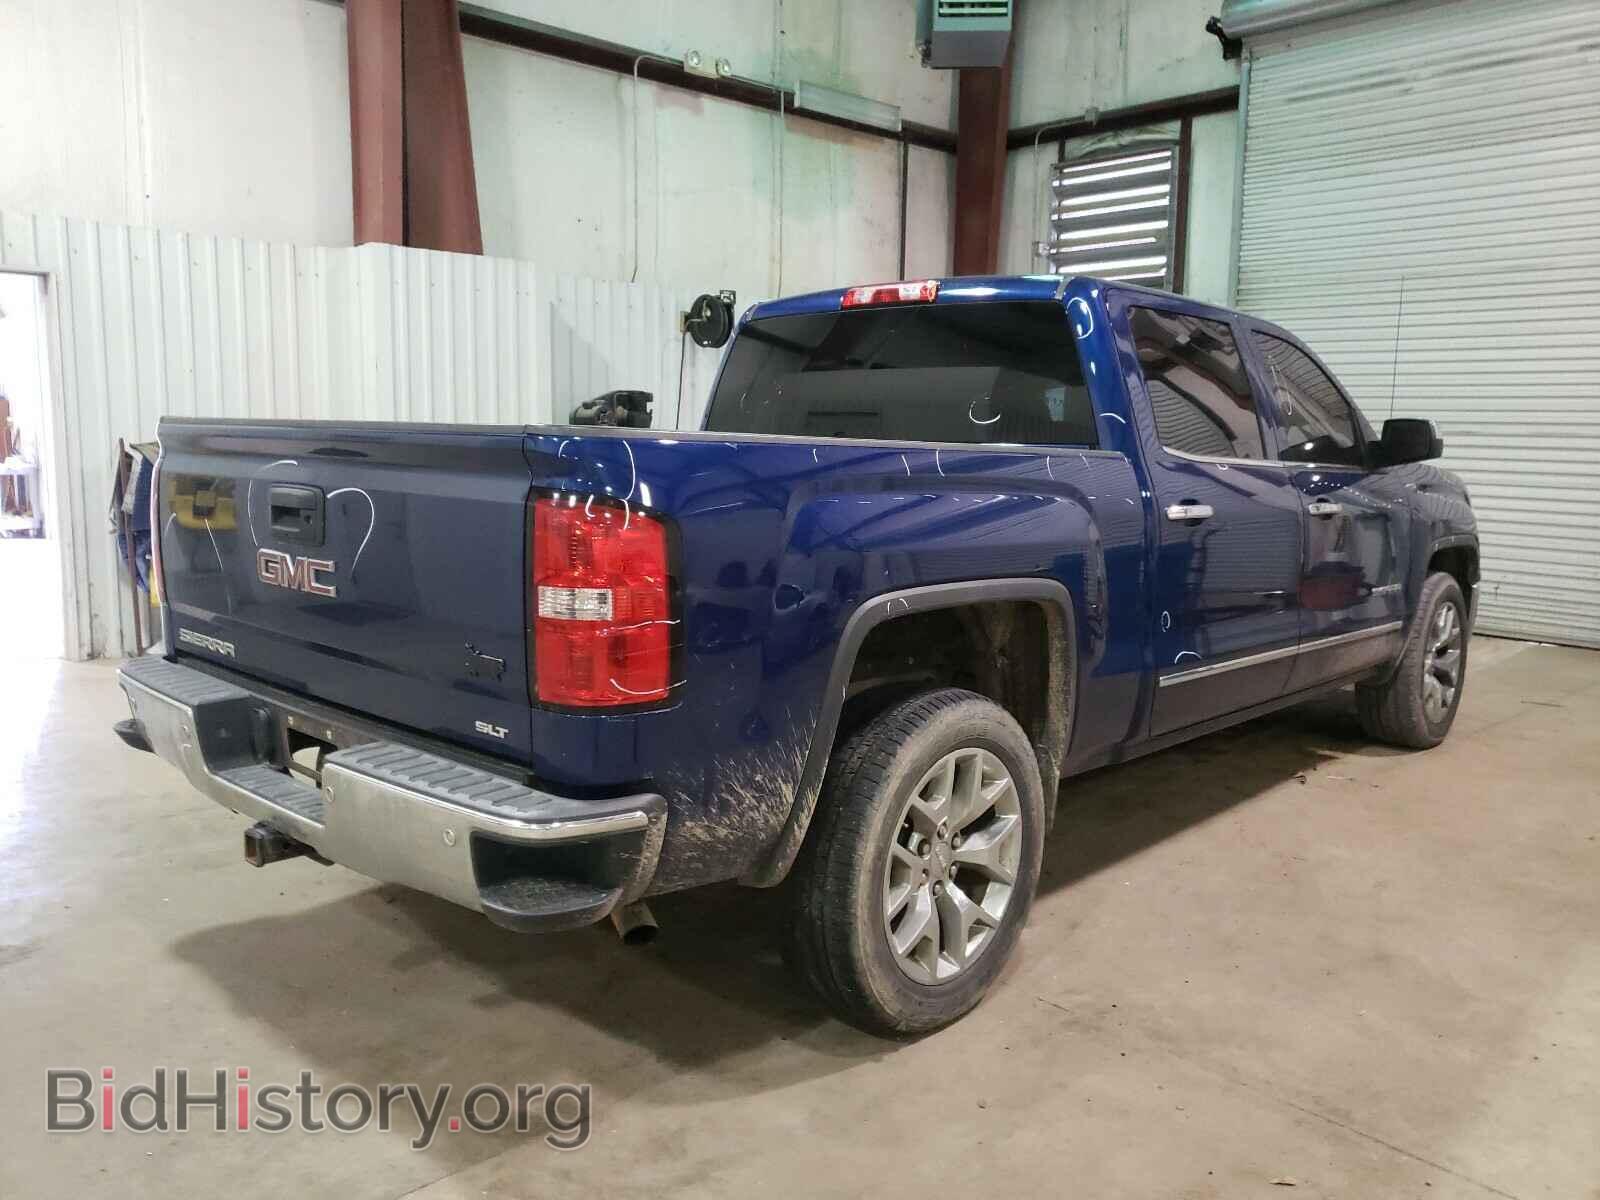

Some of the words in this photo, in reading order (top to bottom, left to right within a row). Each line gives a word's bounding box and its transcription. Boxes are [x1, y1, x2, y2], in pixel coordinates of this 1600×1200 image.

[256, 547, 337, 598] GMC
[178, 627, 236, 658] SIERRA
[475, 720, 509, 739] SLT
